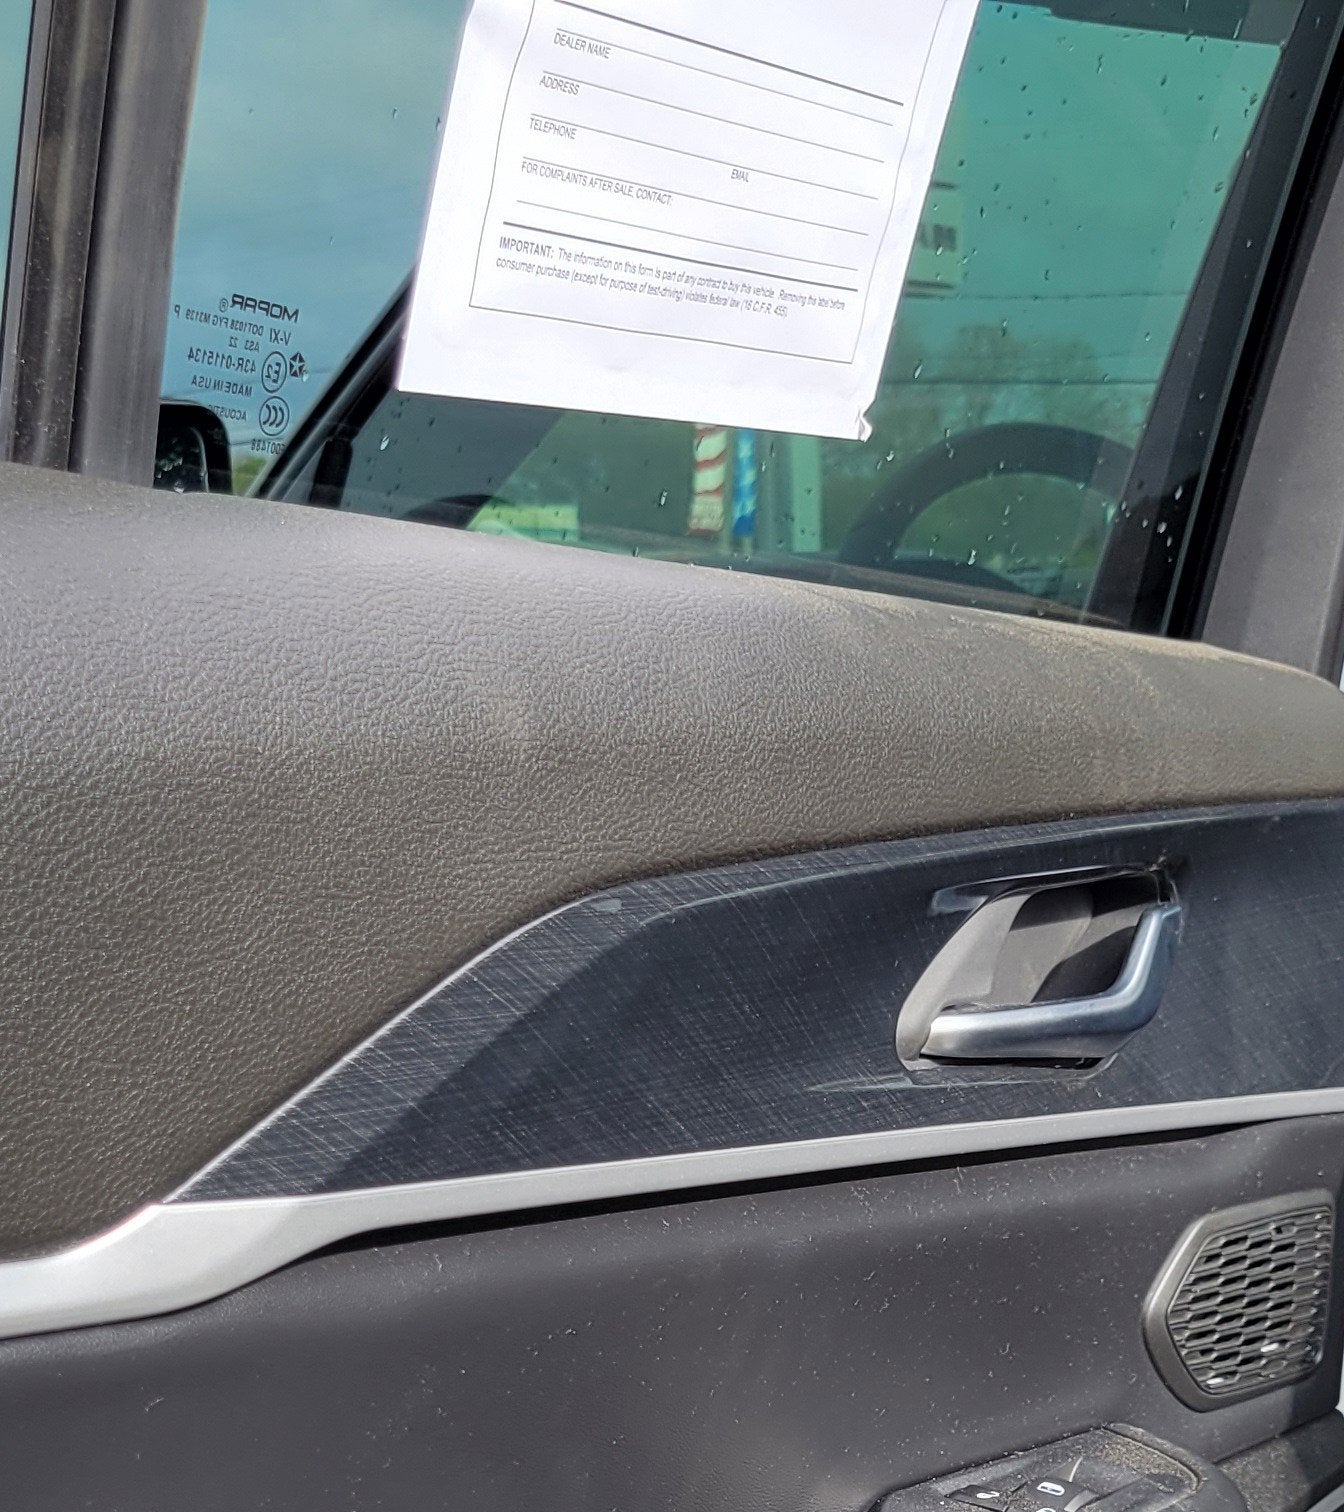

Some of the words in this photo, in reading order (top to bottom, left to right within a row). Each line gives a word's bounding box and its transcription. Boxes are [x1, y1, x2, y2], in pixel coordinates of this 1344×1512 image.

[553, 32, 587, 53] DEALER
[587, 42, 611, 59] NAME
[539, 75, 580, 95] ADDRESS
[530, 117, 577, 140] TELEPHONE
[521, 161, 538, 175] FOR
[539, 165, 588, 187] COMPLAINTS
[589, 177, 613, 192] AFTER
[636, 187, 674, 206] CONTACT:
[731, 168, 750, 183] EMAIL
[499, 235, 555, 259] IMPORTANT:
[558, 247, 573, 262] The
[573, 250, 613, 269] information
[613, 262, 624, 272] on
[624, 261, 637, 274] this
[638, 263, 654, 277] form
[654, 267, 661, 278] is
[661, 269, 677, 282] part
[676, 271, 686, 283] of
[496, 256, 536, 274] consumer
[535, 264, 571, 280] purchase
[570, 269, 599, 286] (except
[599, 273, 609, 286] for
[609, 277, 638, 293] purpose
